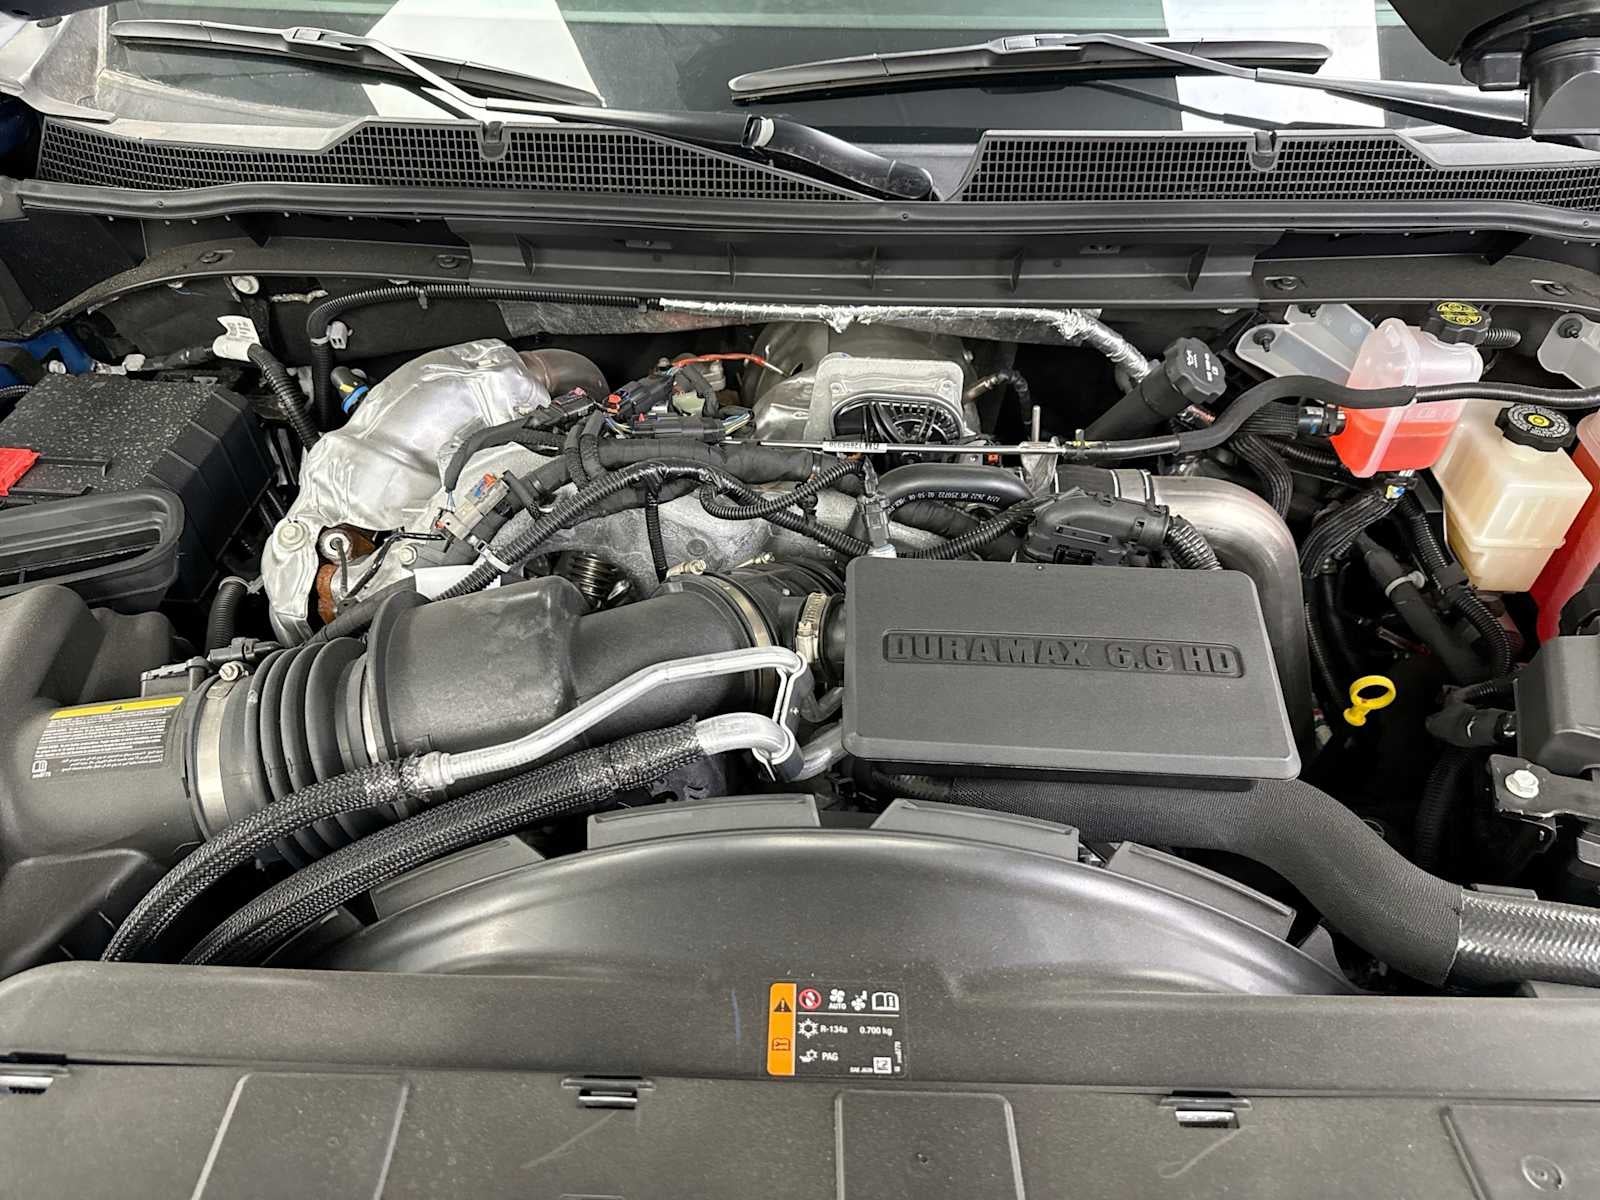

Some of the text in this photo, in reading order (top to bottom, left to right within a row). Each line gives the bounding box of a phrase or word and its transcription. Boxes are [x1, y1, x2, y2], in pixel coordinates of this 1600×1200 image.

[888, 634, 1239, 674] DURAMAX 6.6 HD
[828, 1002, 847, 1010] AUTO
[820, 1025, 893, 1036] R-134a 0.700 kg
[822, 1052, 839, 1061] PAG
